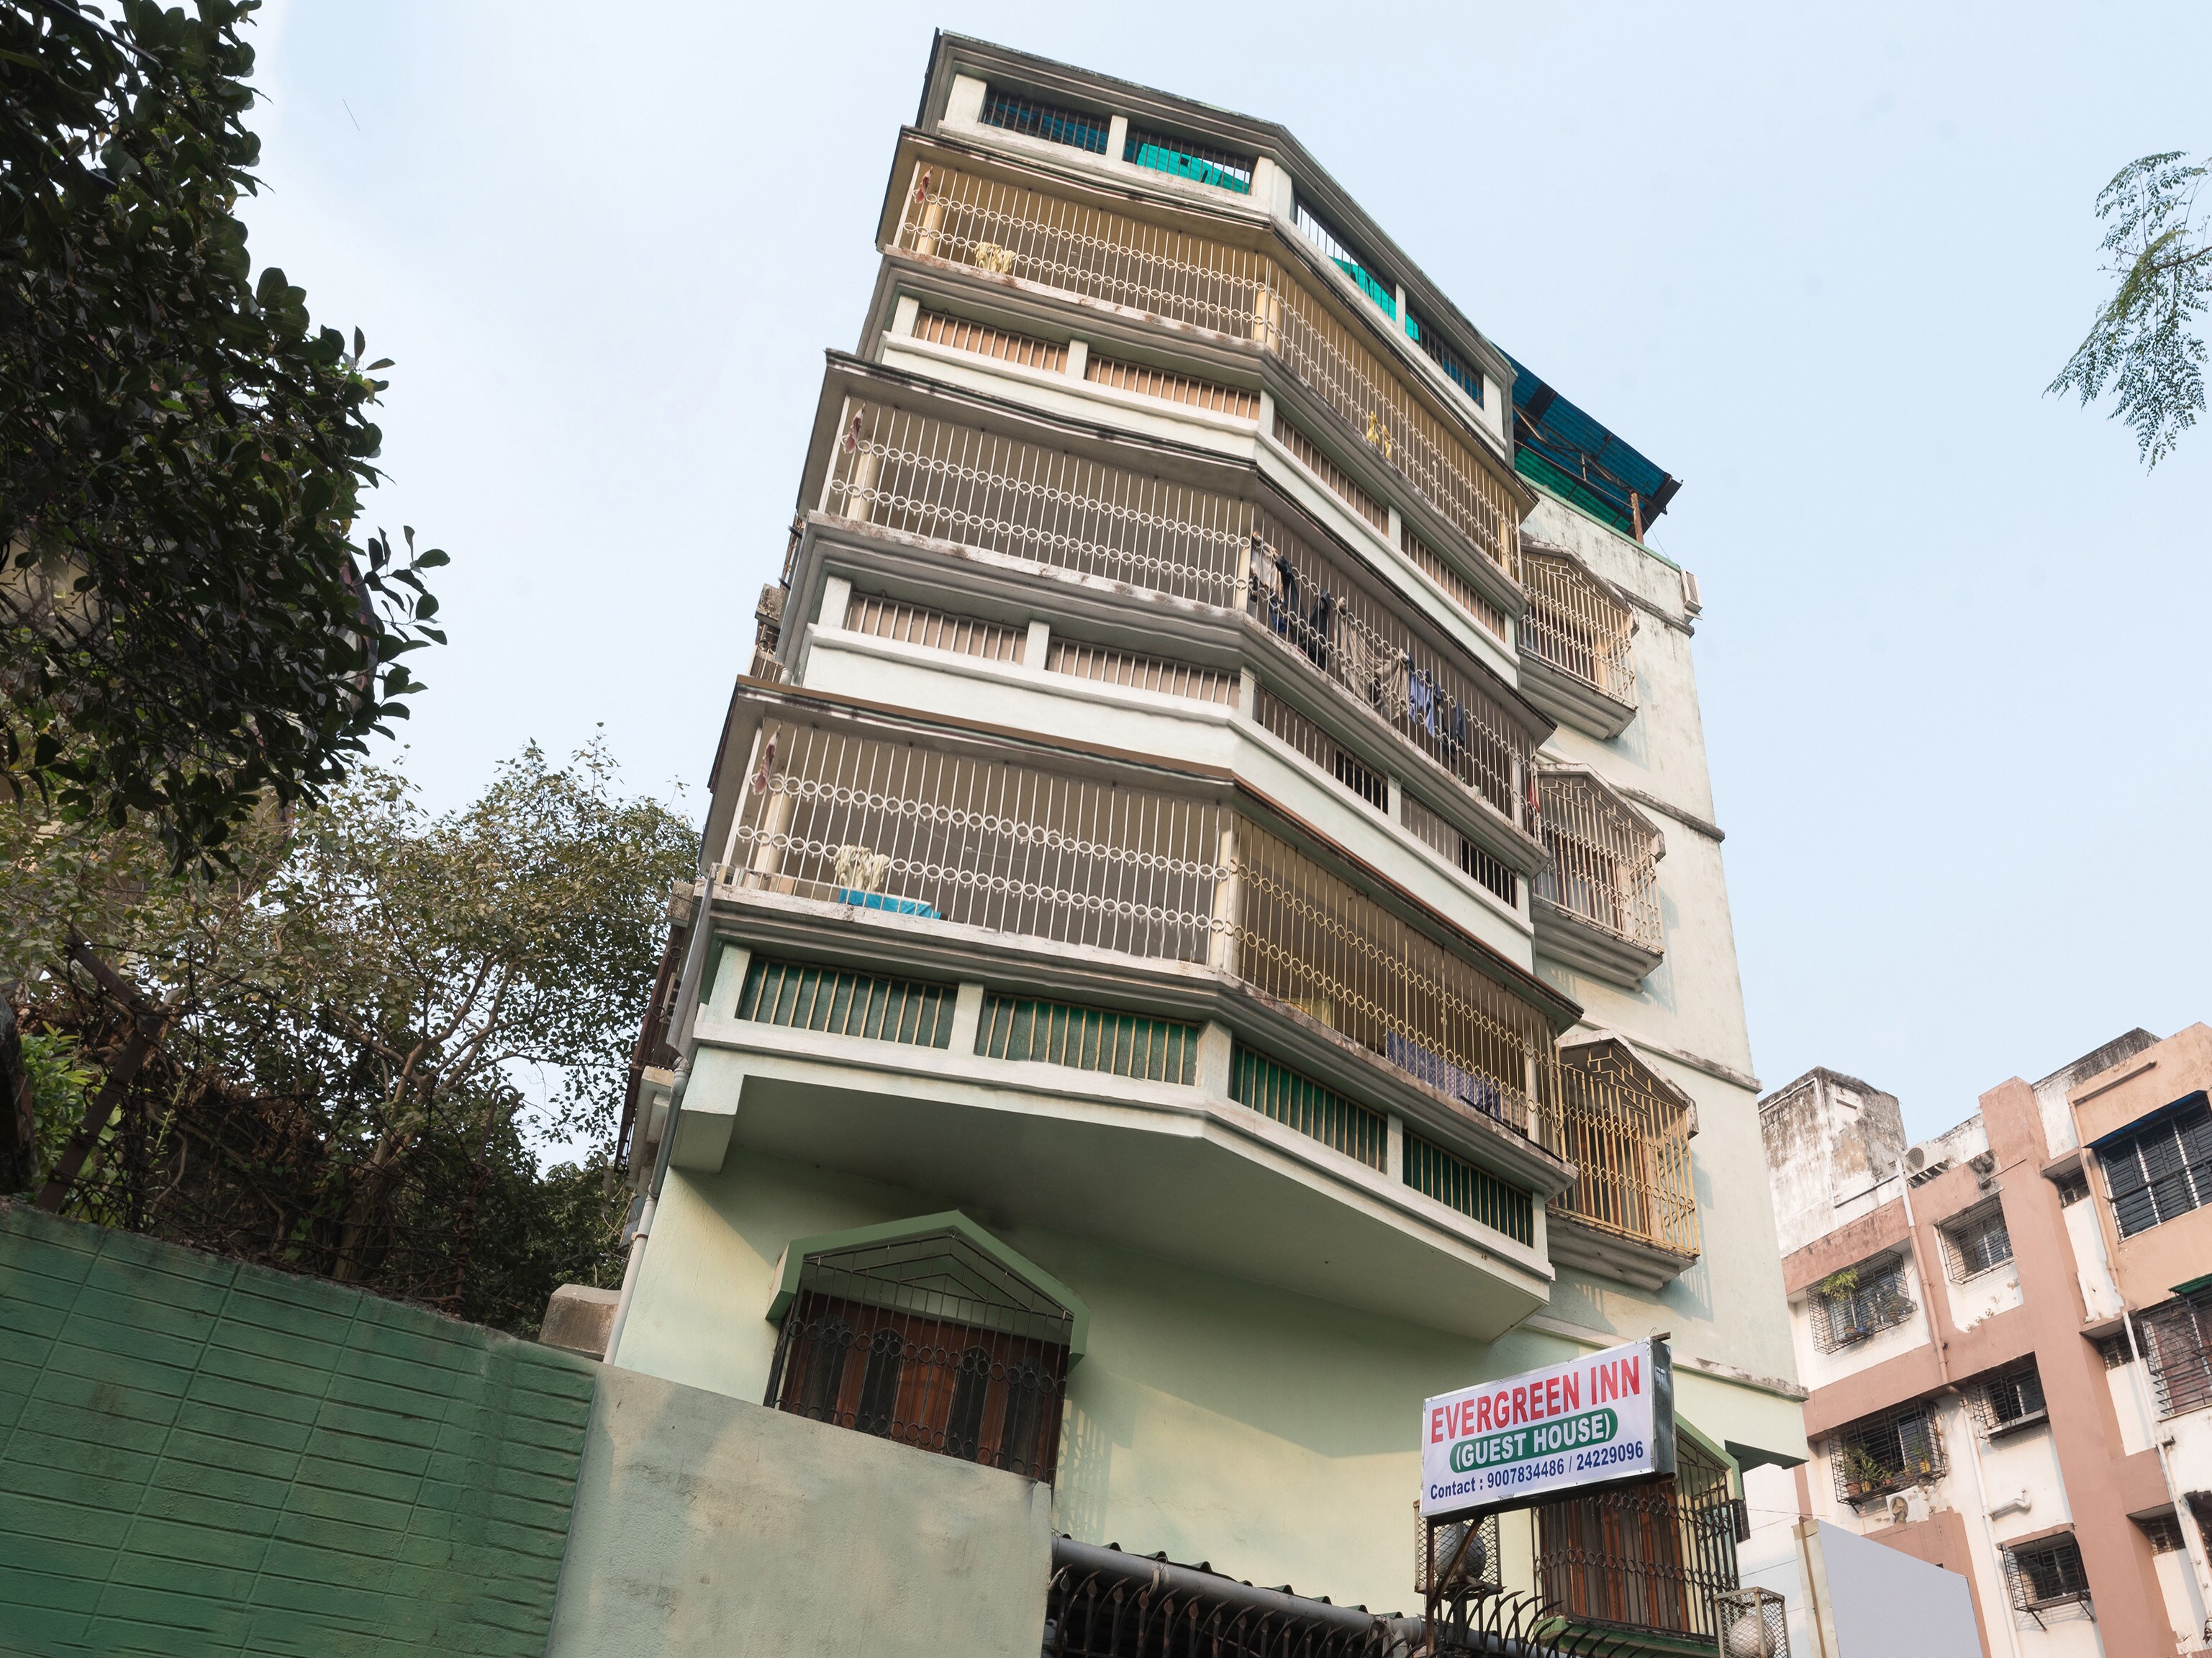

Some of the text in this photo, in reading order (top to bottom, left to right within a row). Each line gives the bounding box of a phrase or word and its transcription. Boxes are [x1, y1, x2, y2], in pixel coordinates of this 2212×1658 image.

[1431, 1355, 1641, 1444] EVERGREEN INN
[1430, 1478, 1476, 1500] Contact
[1487, 1458, 1565, 1488] 9007834486
[1576, 1441, 1644, 1471] 24229096
[1456, 1413, 1611, 1469] (GUEST HOUSE)
